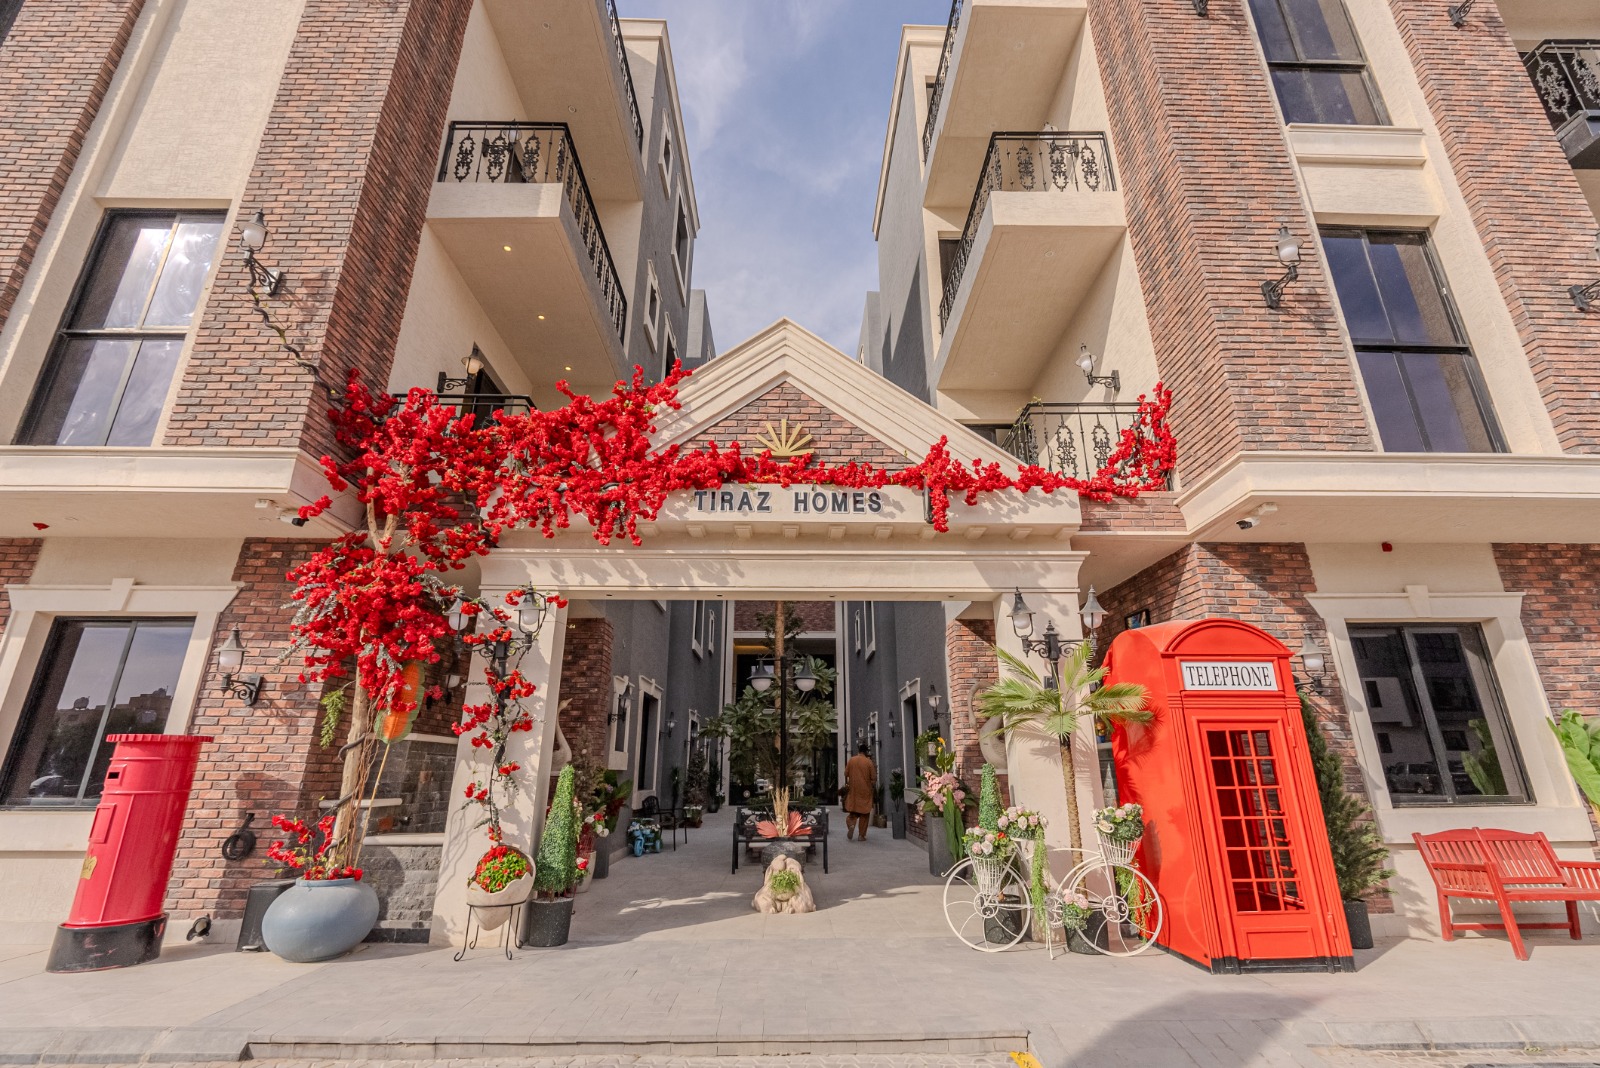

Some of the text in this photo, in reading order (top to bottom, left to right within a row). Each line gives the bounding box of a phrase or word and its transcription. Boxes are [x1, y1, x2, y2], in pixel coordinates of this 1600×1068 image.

[694, 490, 882, 513] TIRAZ HOMES
[1186, 666, 1272, 687] TELEPHONE
